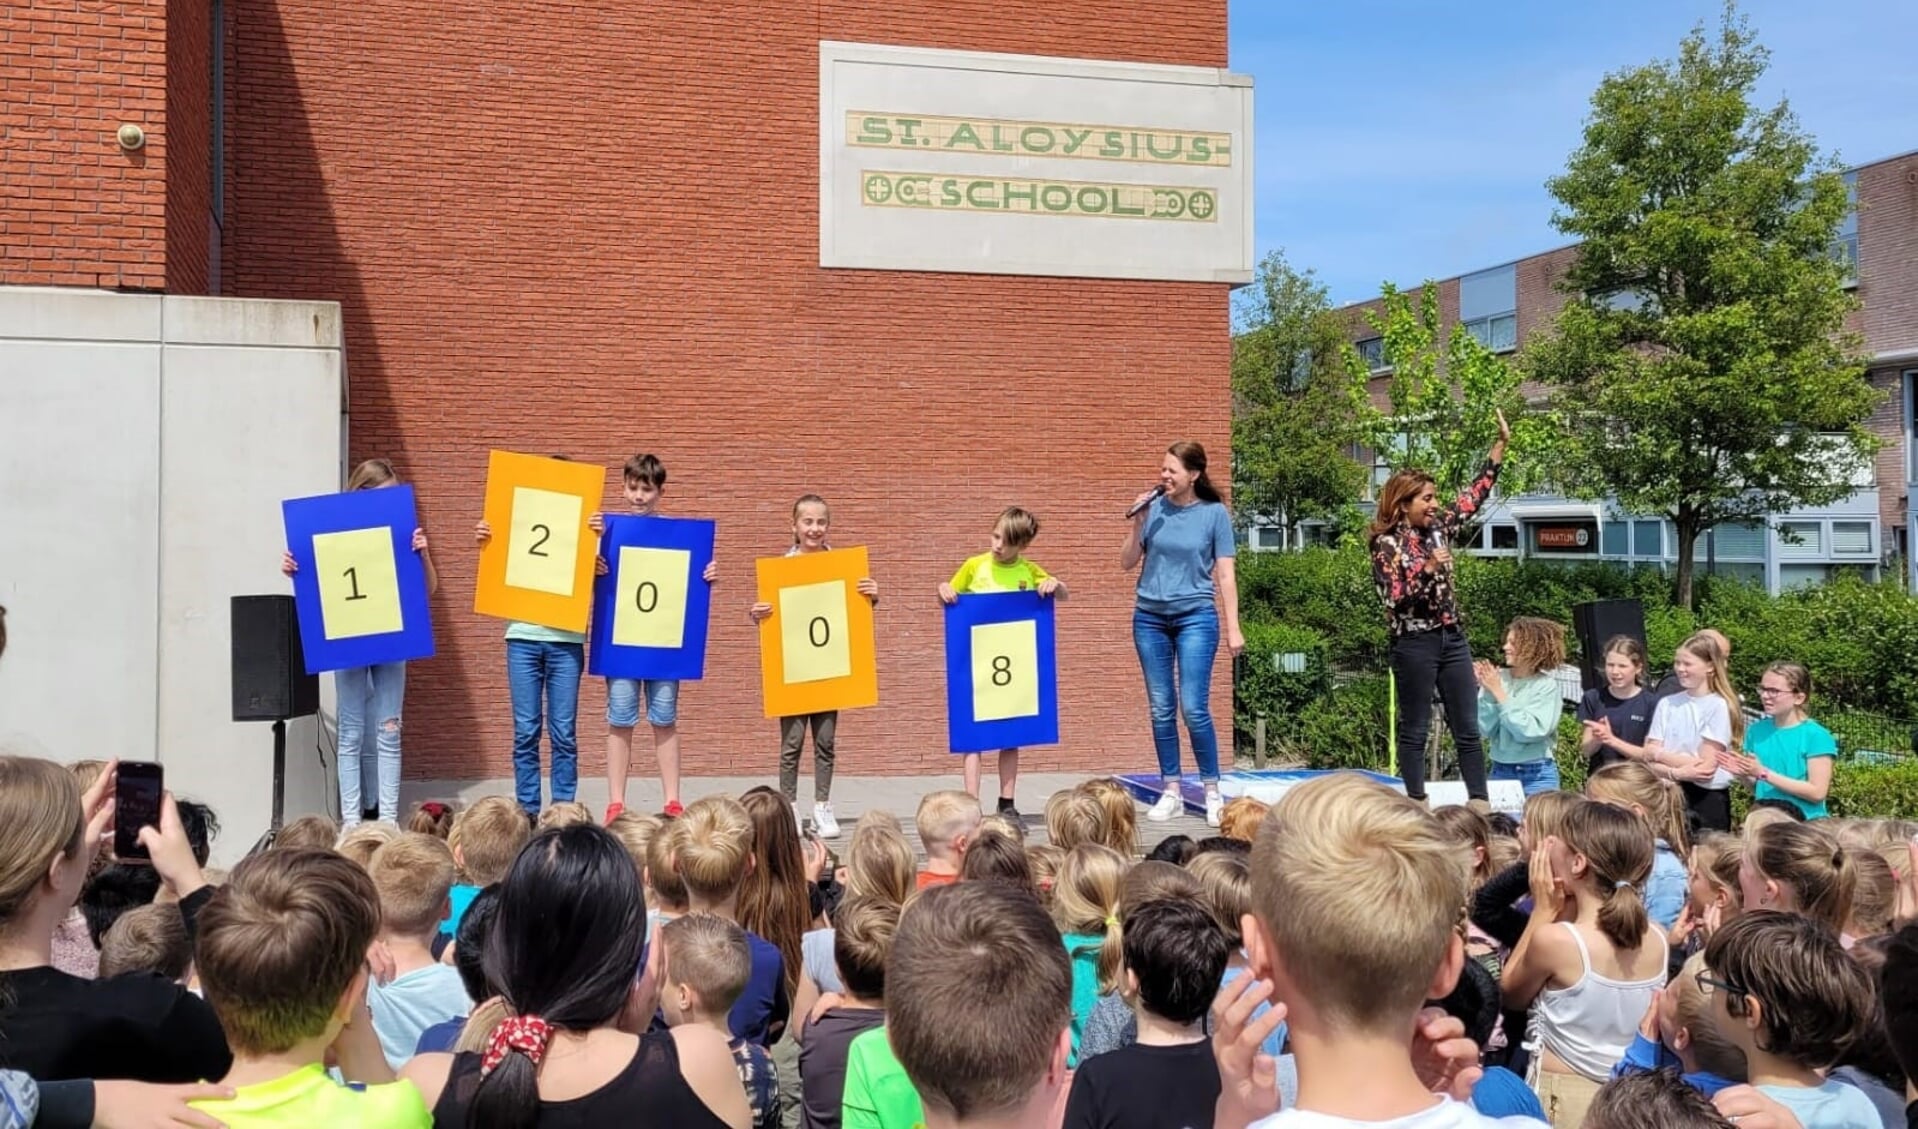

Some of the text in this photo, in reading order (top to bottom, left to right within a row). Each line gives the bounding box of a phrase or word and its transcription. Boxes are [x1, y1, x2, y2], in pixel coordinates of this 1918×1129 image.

[857, 117, 1230, 162] ST. ALOYSIUS-
[941, 179, 1146, 215] SCHOOL
[528, 524, 550, 557] 2
[343, 567, 367, 601] 1
[636, 581, 658, 613] 0
[809, 616, 830, 648] 0
[992, 655, 1012, 686] 8
